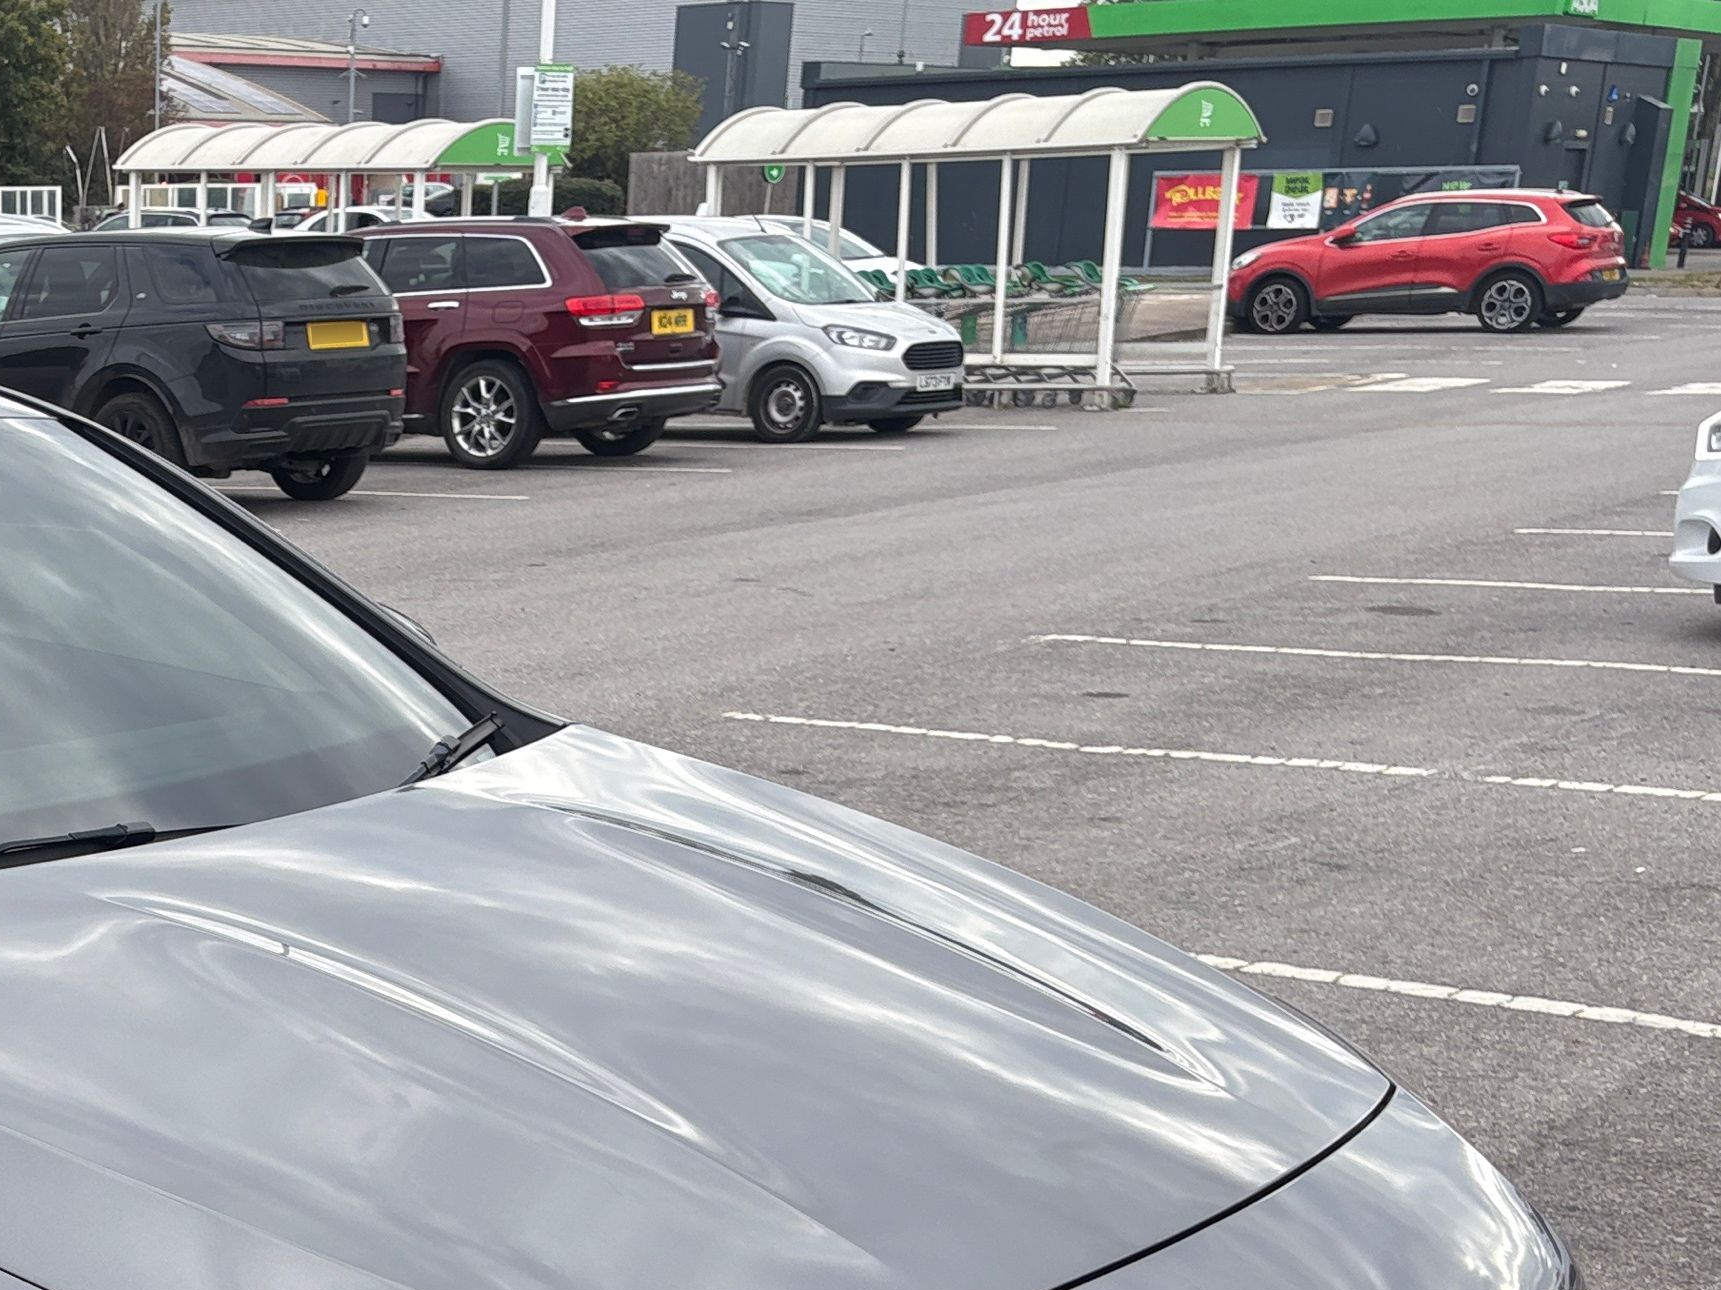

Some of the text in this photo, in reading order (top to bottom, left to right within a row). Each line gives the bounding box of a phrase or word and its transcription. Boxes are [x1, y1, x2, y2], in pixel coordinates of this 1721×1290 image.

[982, 12, 1023, 42] 24
[1027, 12, 1069, 26] hour
[1025, 23, 1068, 41] petrol
